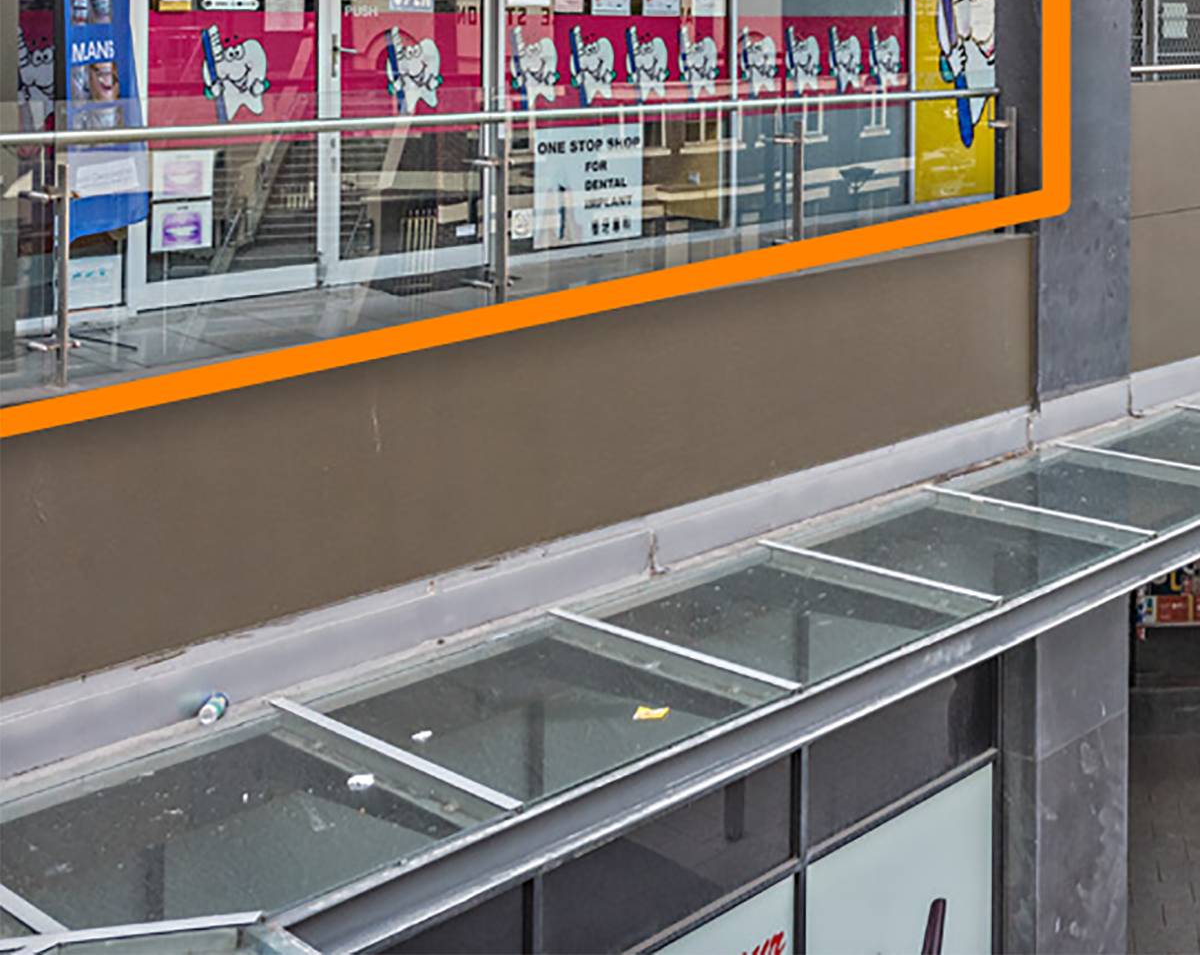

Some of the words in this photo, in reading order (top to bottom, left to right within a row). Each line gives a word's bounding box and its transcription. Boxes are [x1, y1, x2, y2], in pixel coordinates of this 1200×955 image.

[344, 5, 379, 17] PUSH
[537, 141, 566, 155] ONE
[570, 138, 603, 153] STOP
[607, 136, 640, 150] SHOP
[585, 160, 607, 172] FOR
[584, 177, 627, 192] DENTAL
